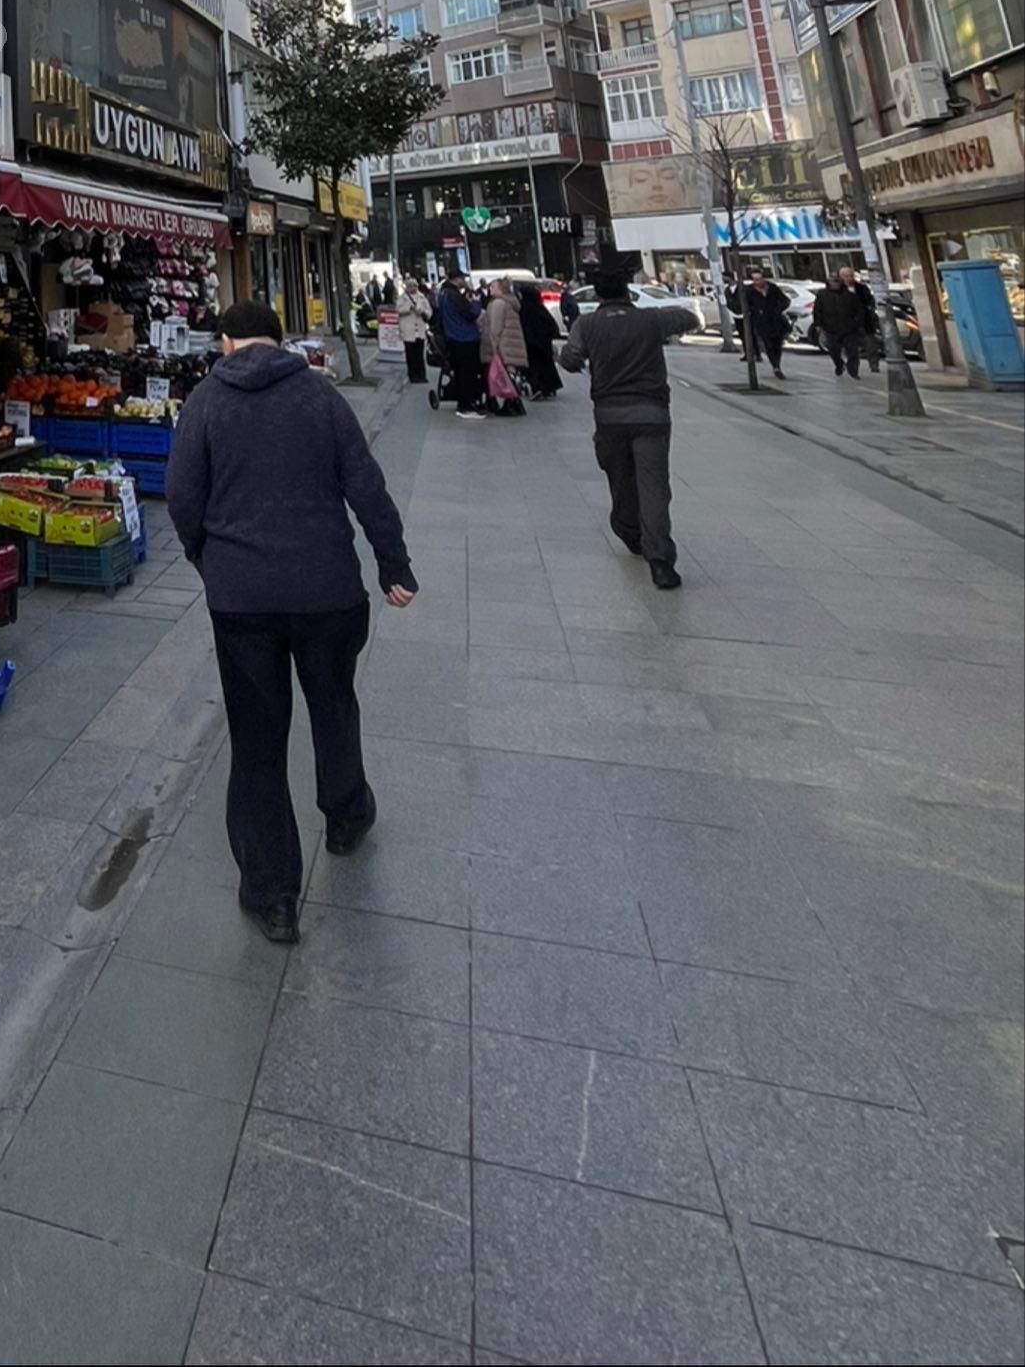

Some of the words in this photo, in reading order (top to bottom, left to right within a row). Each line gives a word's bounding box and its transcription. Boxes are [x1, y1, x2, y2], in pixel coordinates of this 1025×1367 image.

[93, 100, 165, 162] UYGUN
[169, 132, 202, 172] AVM
[61, 193, 108, 224] VATAN
[110, 204, 179, 231] MARKETLER
[181, 216, 214, 238] GRUBU
[541, 216, 572, 234] COFFY
